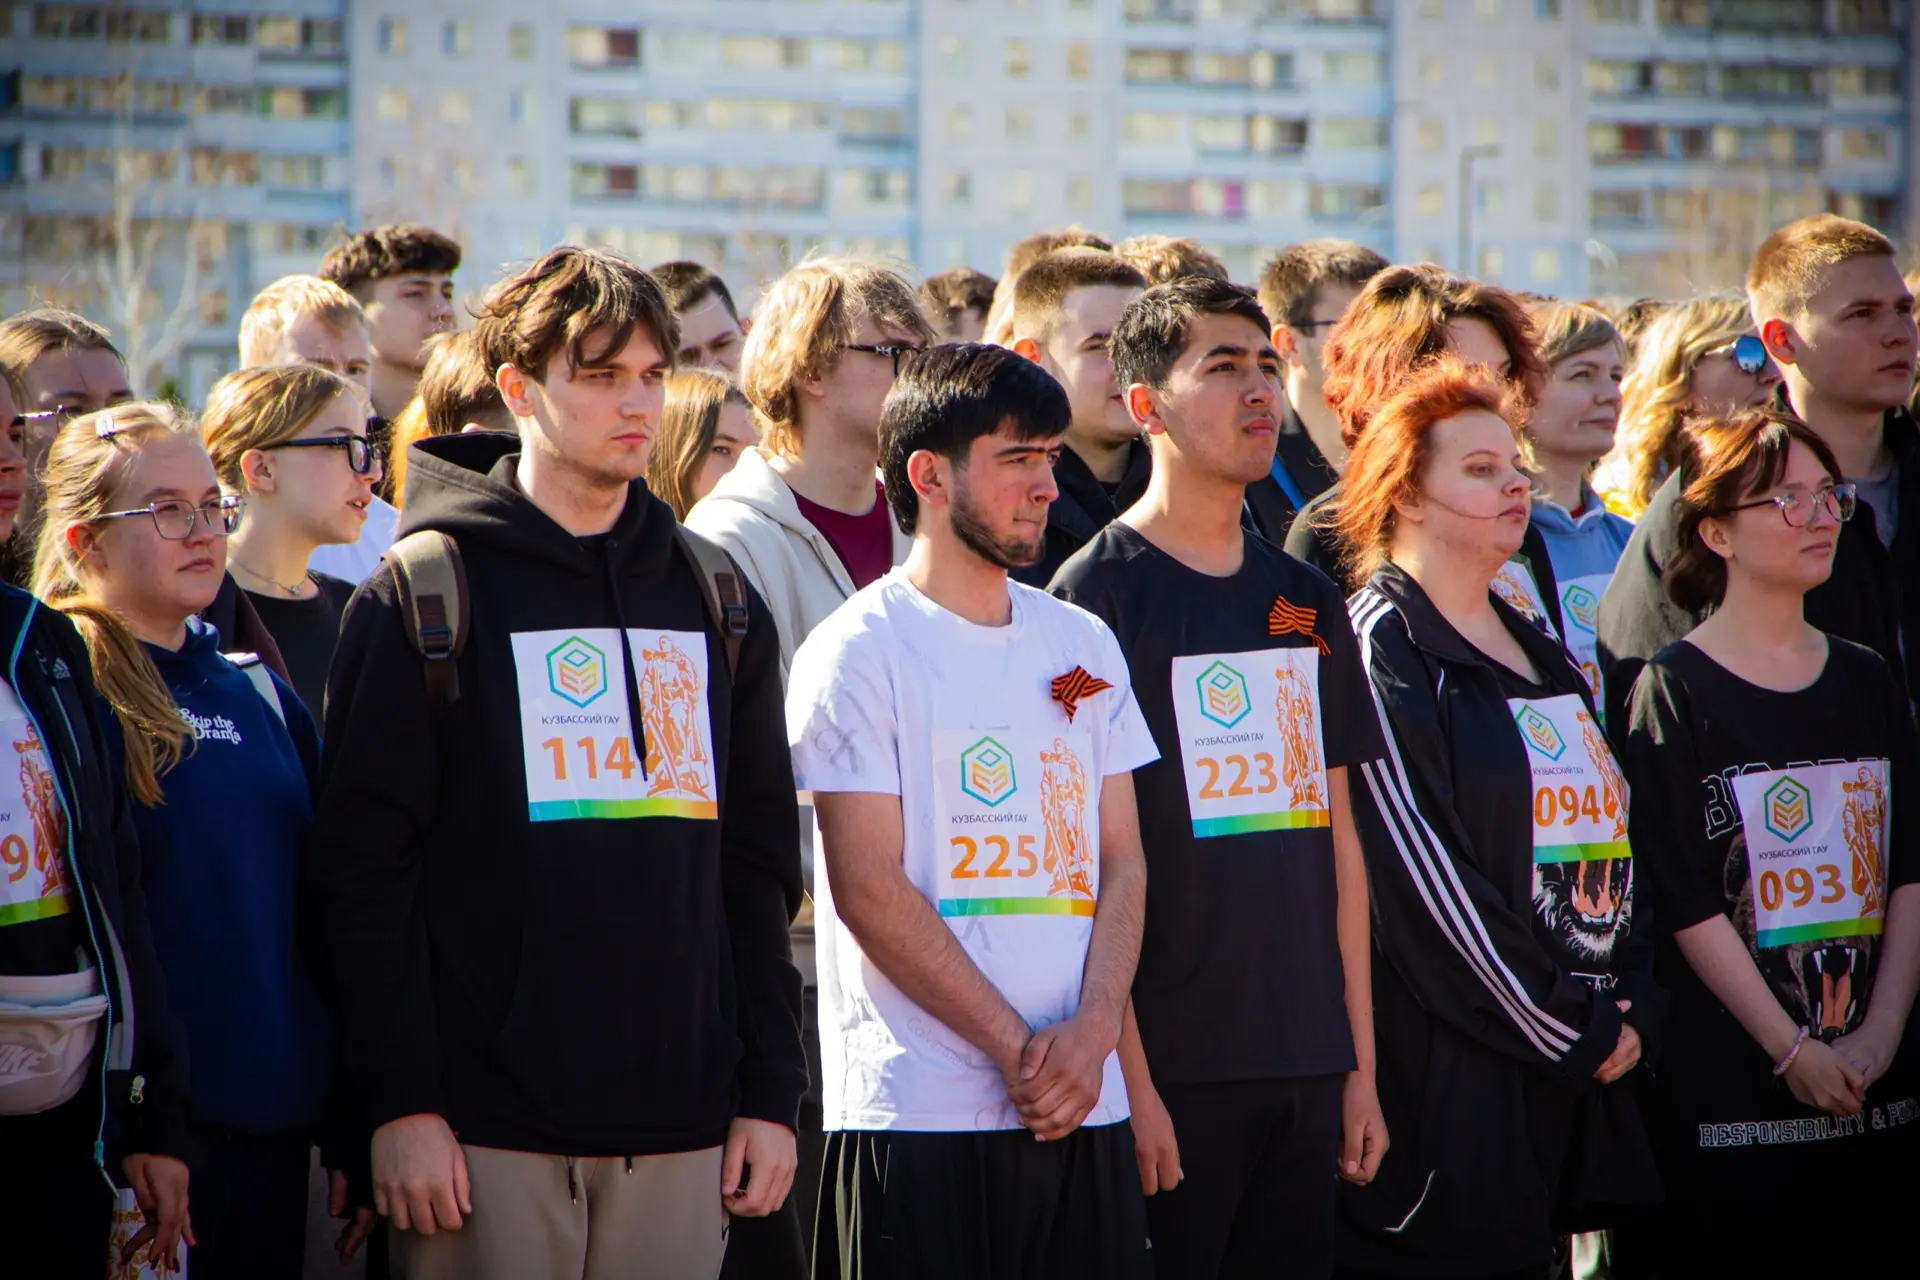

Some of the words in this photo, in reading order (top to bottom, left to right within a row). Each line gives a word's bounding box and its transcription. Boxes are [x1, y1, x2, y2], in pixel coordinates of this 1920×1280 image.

[212, 715, 236, 729] the
[541, 713, 602, 725] КУЗБАССКИЙ
[604, 714, 620, 724] ГАУ
[1194, 731, 1249, 747] КУЗБАССКИЙ
[1251, 732, 1265, 742] ГАУ
[542, 736, 636, 781] 114
[1195, 752, 1278, 800] 223
[951, 813, 1013, 824] КУЗБАССКИЙ
[1014, 814, 1028, 823] ГАУ
[1534, 784, 1602, 828] 094
[950, 835, 1038, 879] 225
[1759, 847, 1811, 860] КУЗБАССКИЙ
[1812, 845, 1828, 855] ГАУ
[1759, 863, 1846, 911] 093
[1699, 1111, 1865, 1147] RESPONSIBILITY
[1871, 1107, 1887, 1131] &
